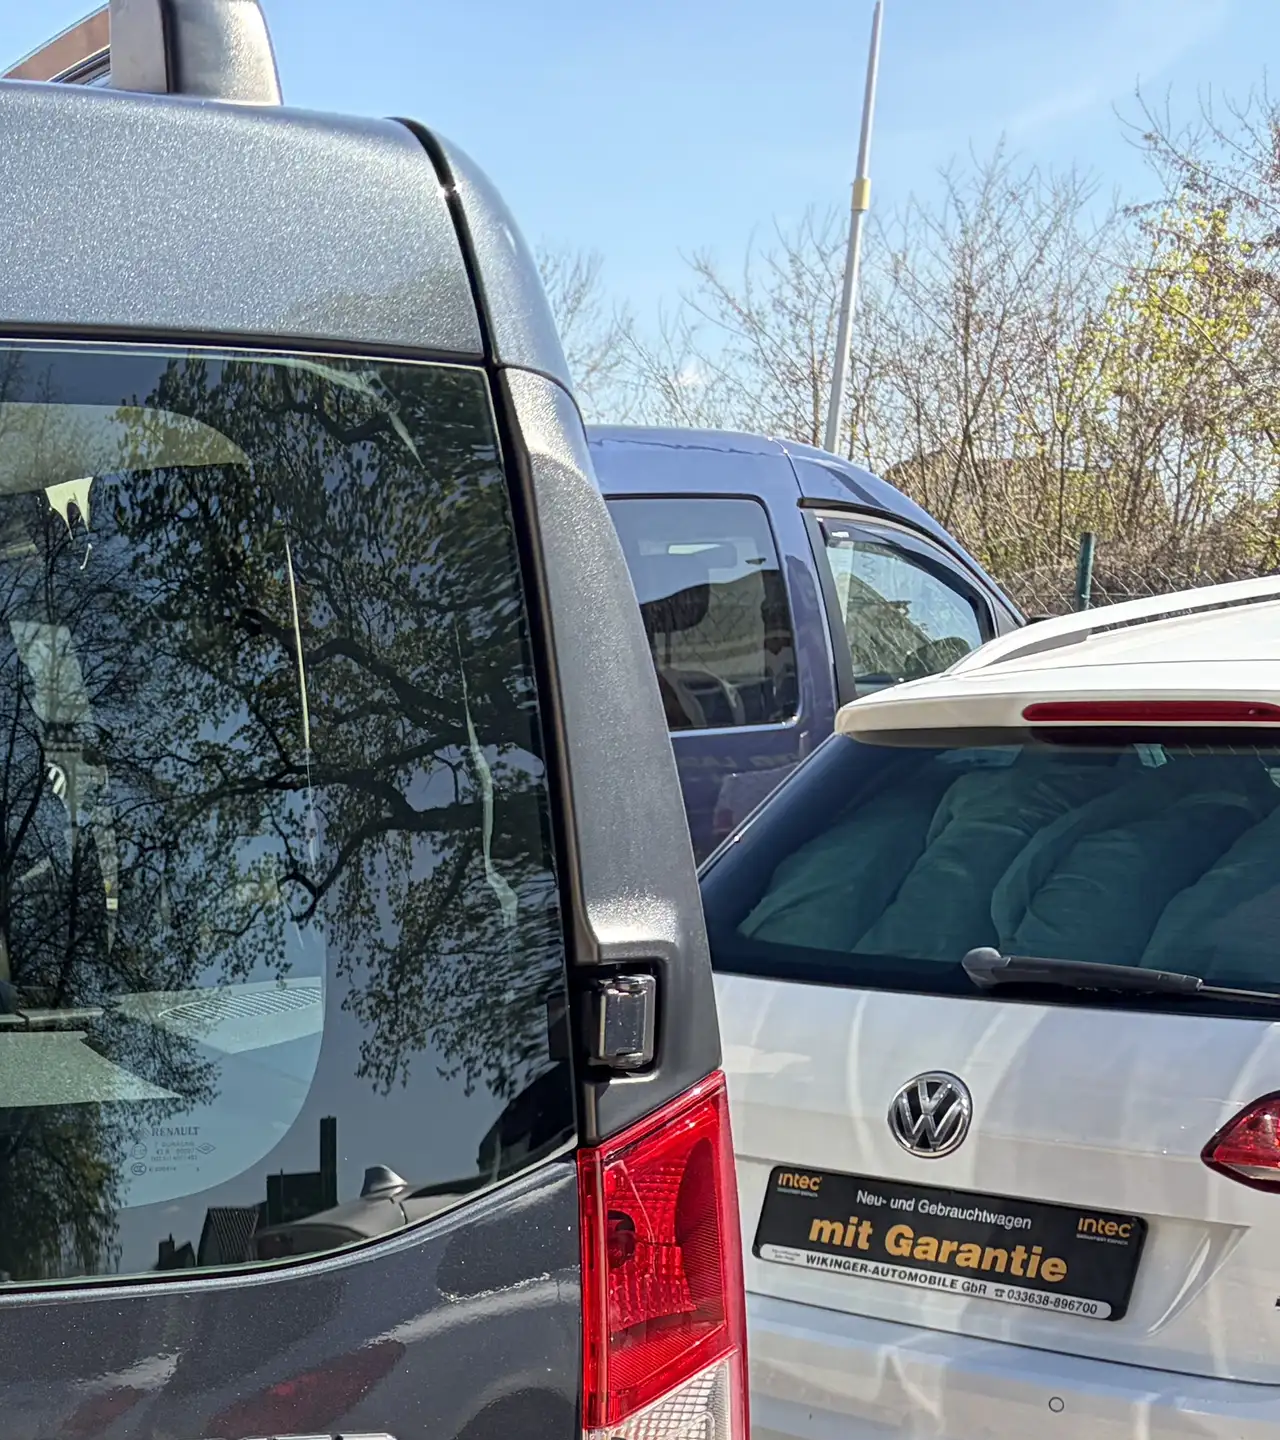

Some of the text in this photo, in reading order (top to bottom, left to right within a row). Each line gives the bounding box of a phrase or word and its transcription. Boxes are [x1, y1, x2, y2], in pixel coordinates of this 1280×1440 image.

[151, 1126, 200, 1137] RENAULT
[777, 1172, 822, 1191] intec
[856, 1189, 1032, 1231] Neu- und Gebrauchtwagen
[1077, 1217, 1134, 1239] intec
[809, 1215, 1068, 1283] mit Garantie
[806, 1253, 959, 1290] WIKINGER-AUTOMOBILE
[961, 1281, 987, 1295] GbR
[1006, 1288, 1098, 1315] 033638-896700
